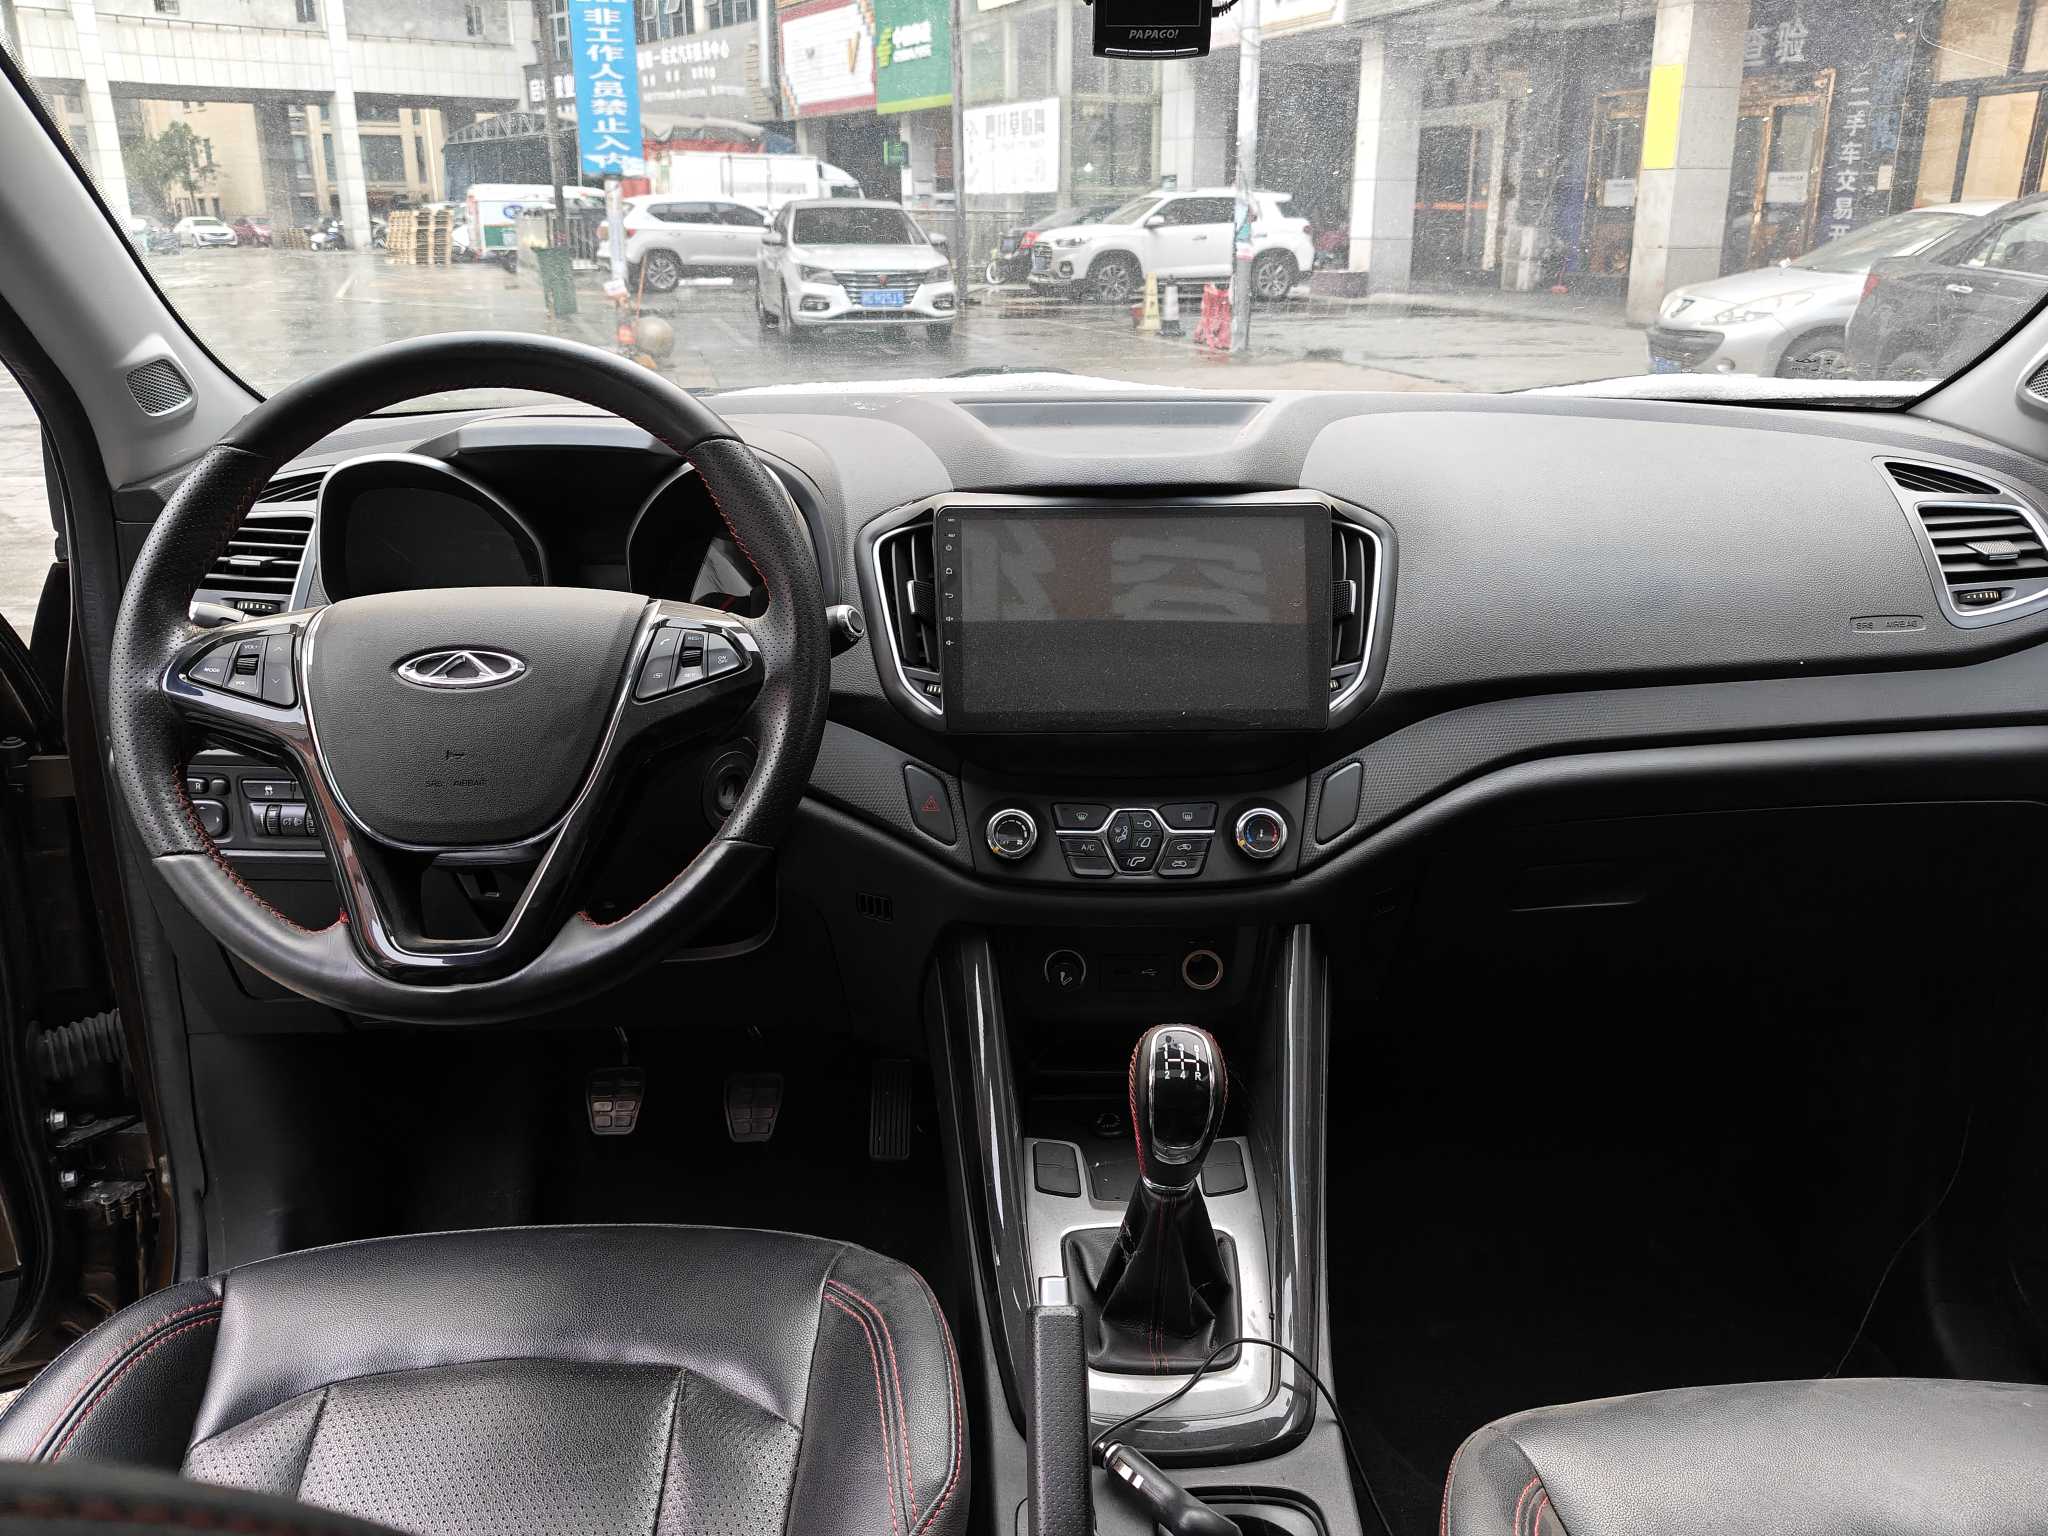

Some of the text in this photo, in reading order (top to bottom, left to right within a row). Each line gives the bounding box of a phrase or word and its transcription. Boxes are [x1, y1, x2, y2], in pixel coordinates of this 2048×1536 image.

[1128, 28, 1179, 40] PAPAGO!
[1886, 620, 1918, 629] AIRBAG
[1081, 843, 1095, 851] A/C
[1164, 1070, 1202, 1081] 2 4 R
